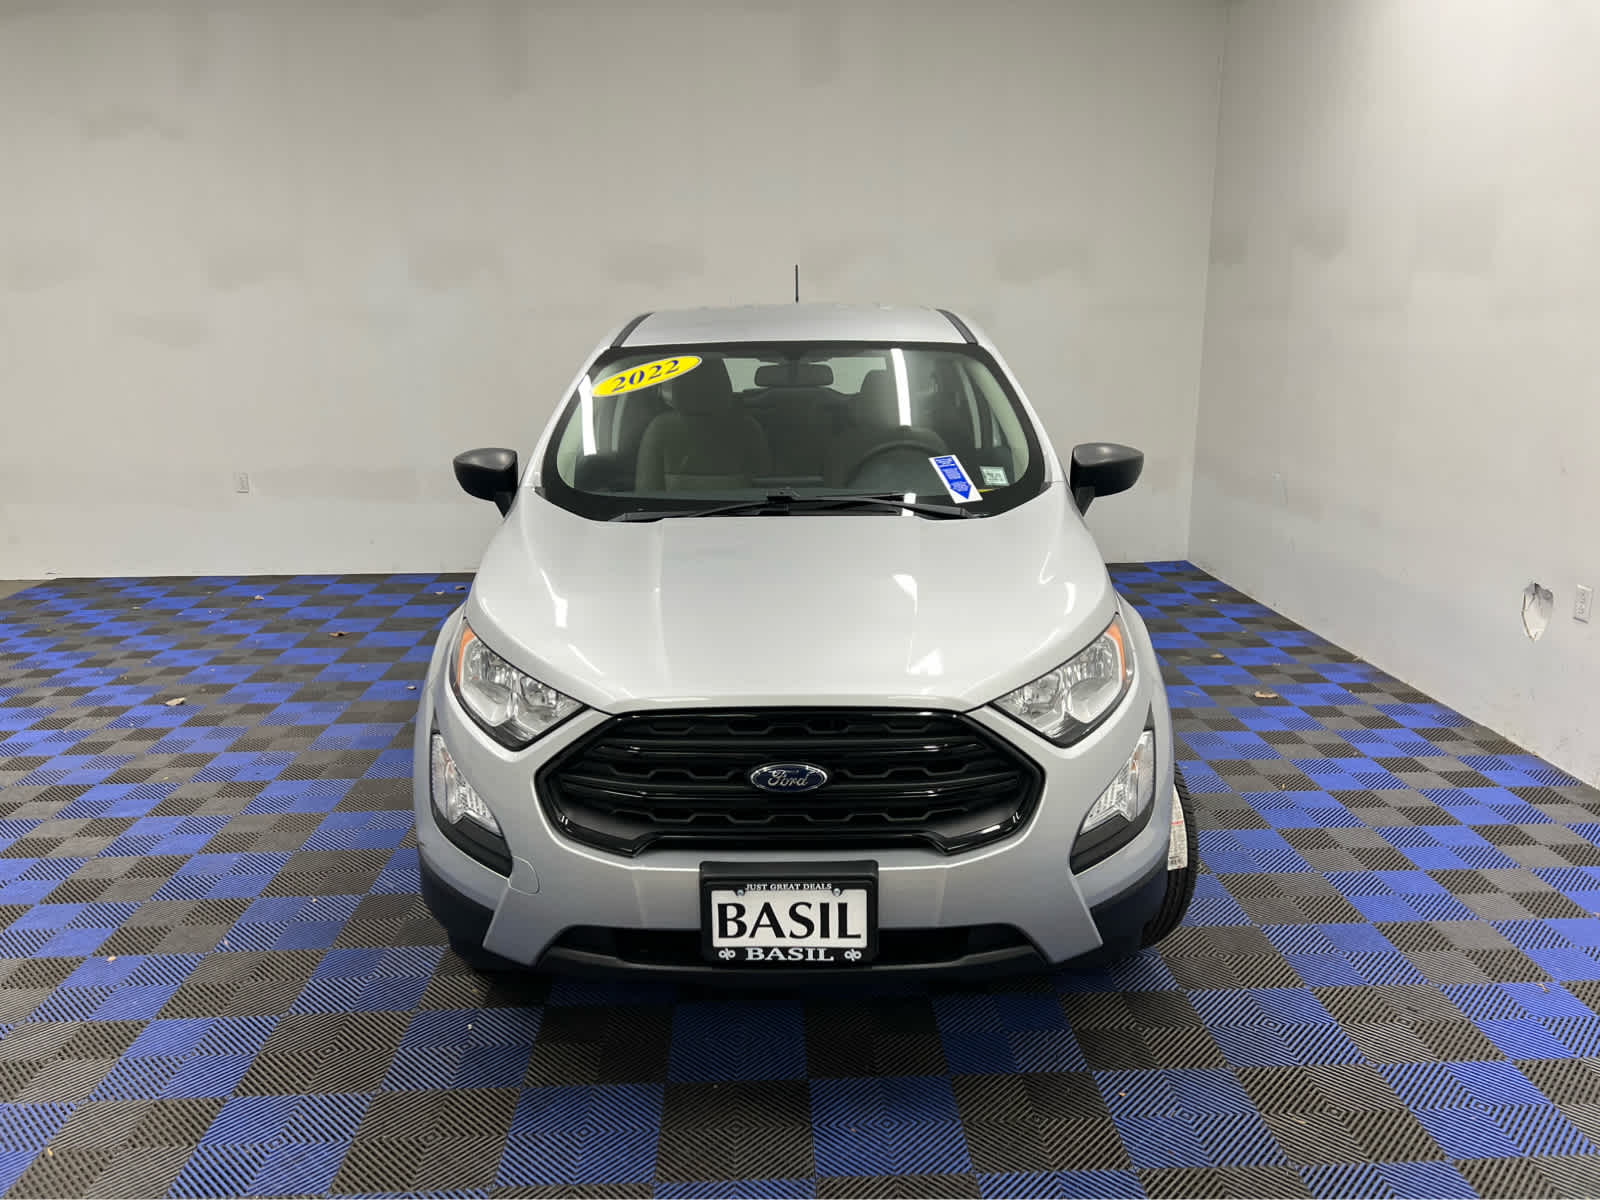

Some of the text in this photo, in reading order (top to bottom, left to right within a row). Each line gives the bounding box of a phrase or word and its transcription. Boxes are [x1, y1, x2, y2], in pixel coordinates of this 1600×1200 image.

[611, 360, 680, 392] 2022
[767, 769, 812, 787] Ford
[717, 902, 862, 939] BASIL
[745, 948, 834, 961] BASIL
